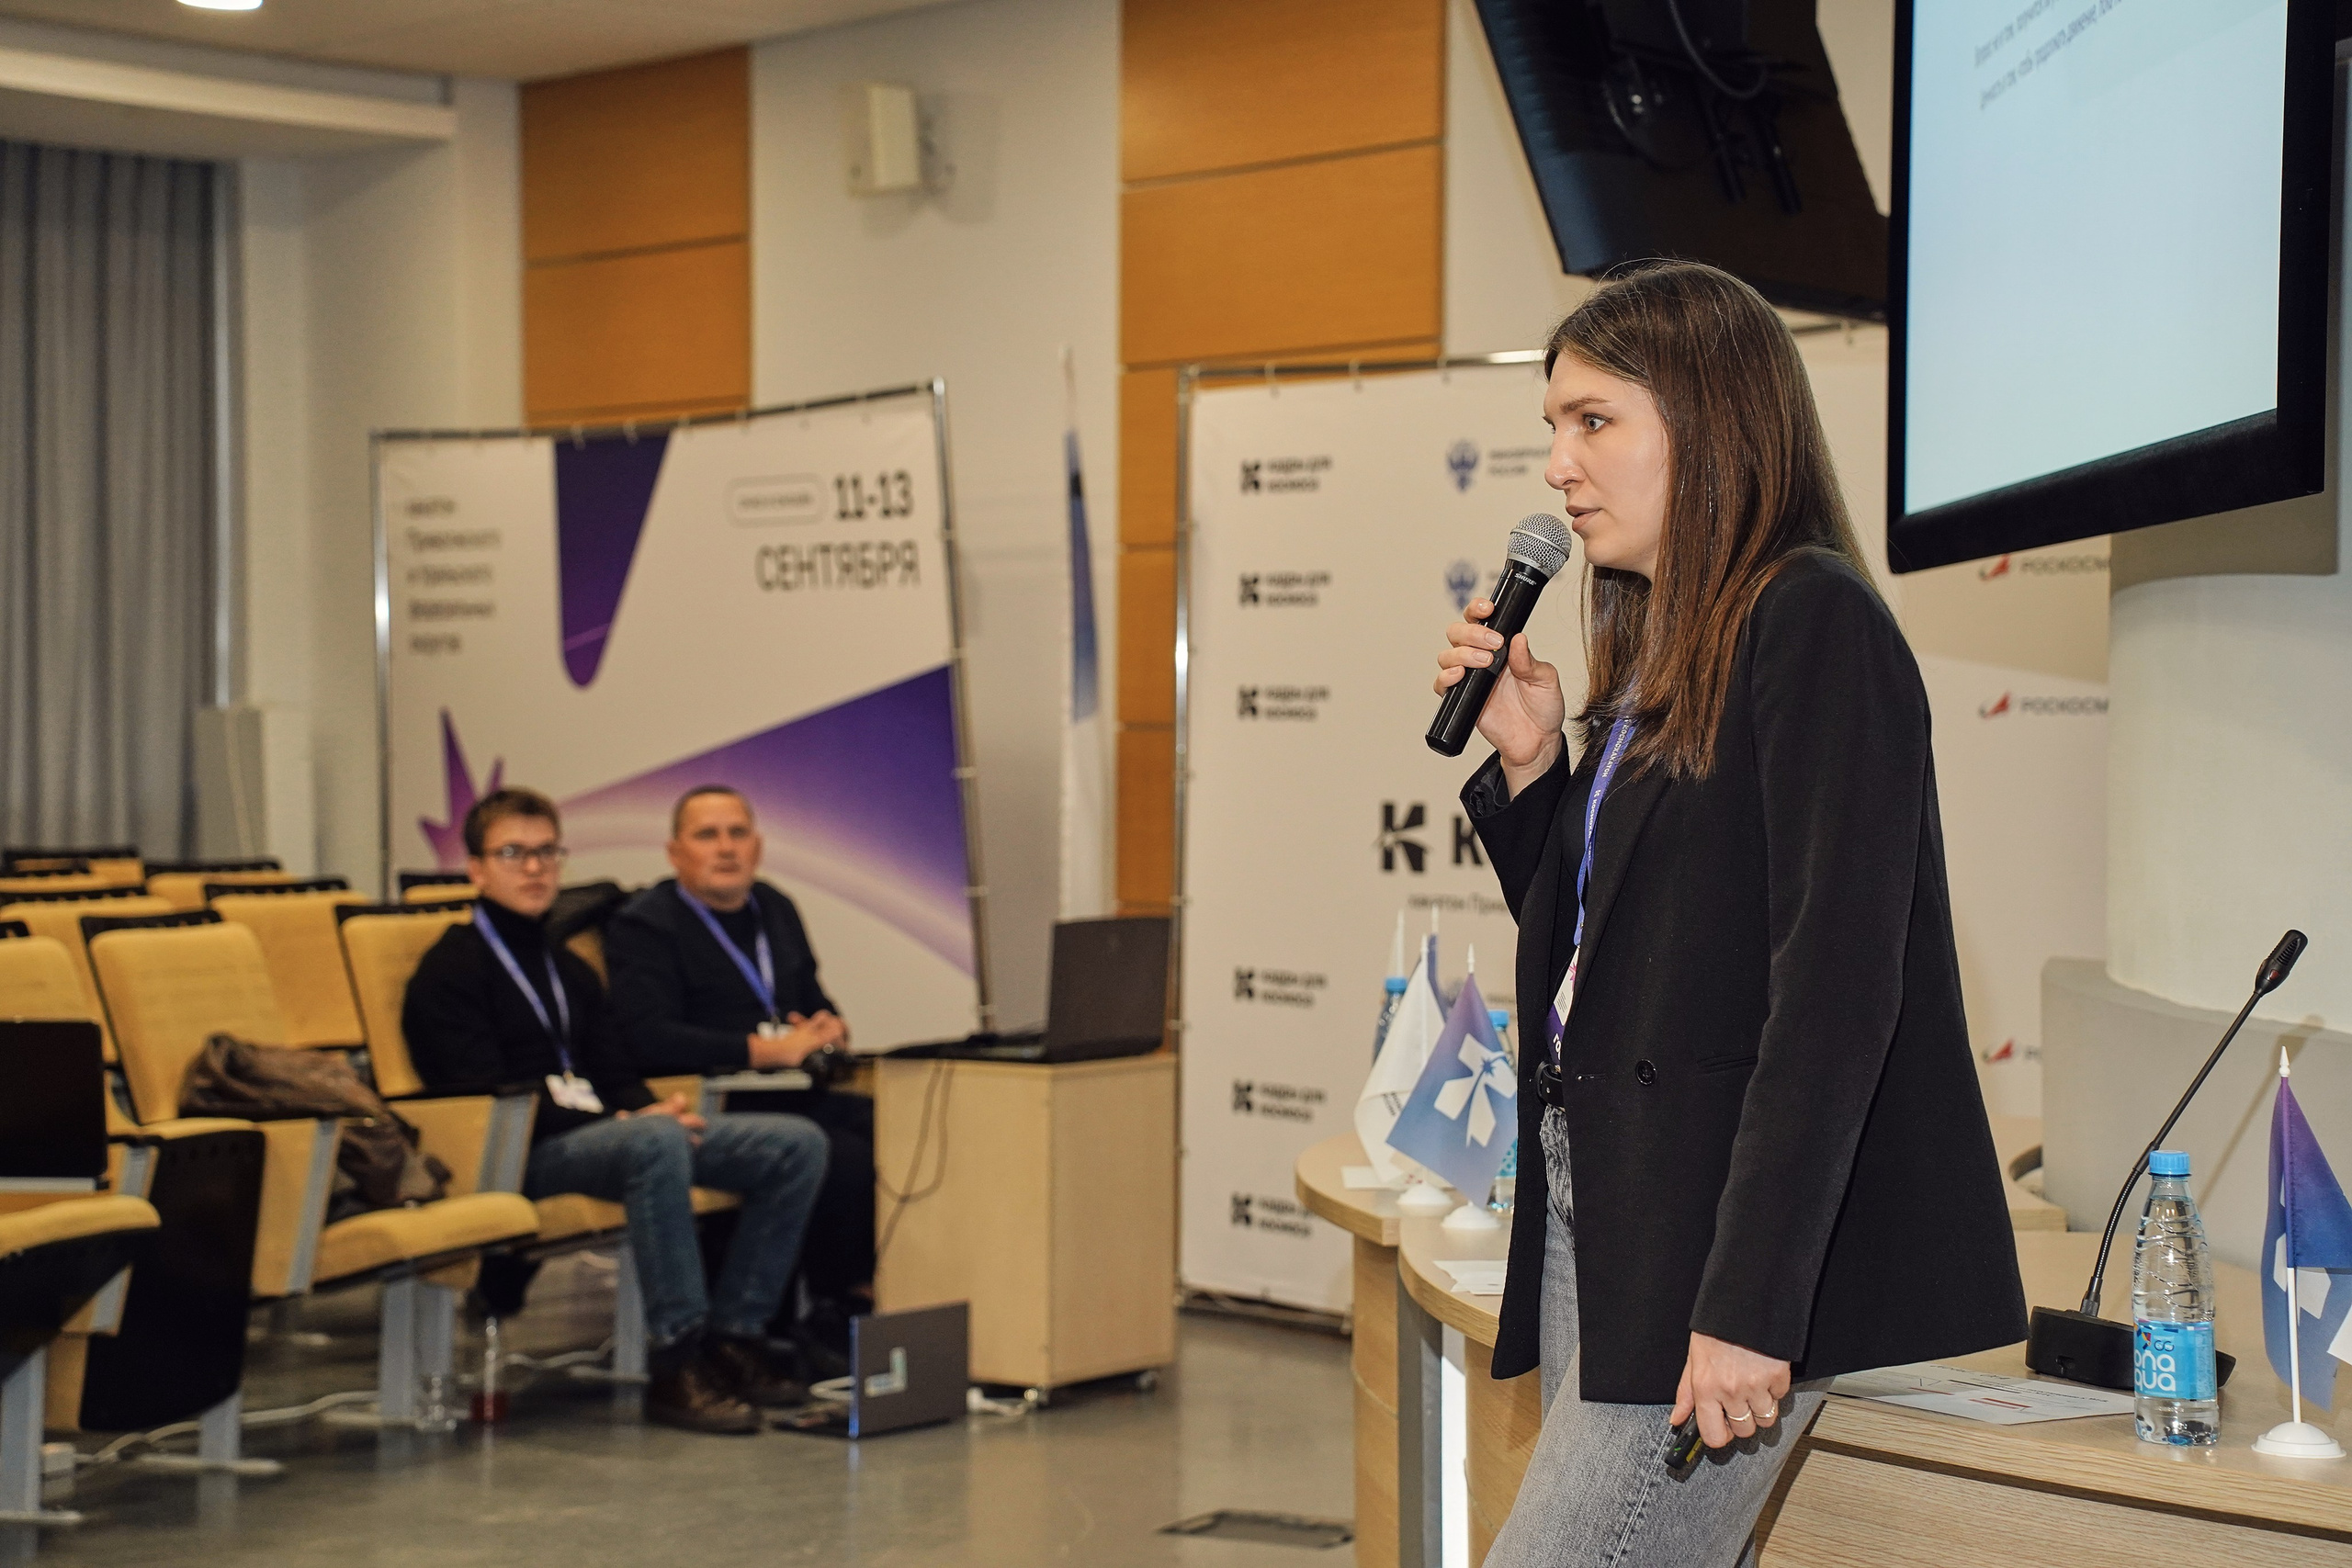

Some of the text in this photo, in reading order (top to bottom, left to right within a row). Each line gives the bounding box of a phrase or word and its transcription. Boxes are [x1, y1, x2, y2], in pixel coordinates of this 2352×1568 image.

[834, 470, 913, 522] 11-13
[754, 540, 921, 592] СЕНТЯБРЯ
[1514, 571, 1535, 586] SHURE
